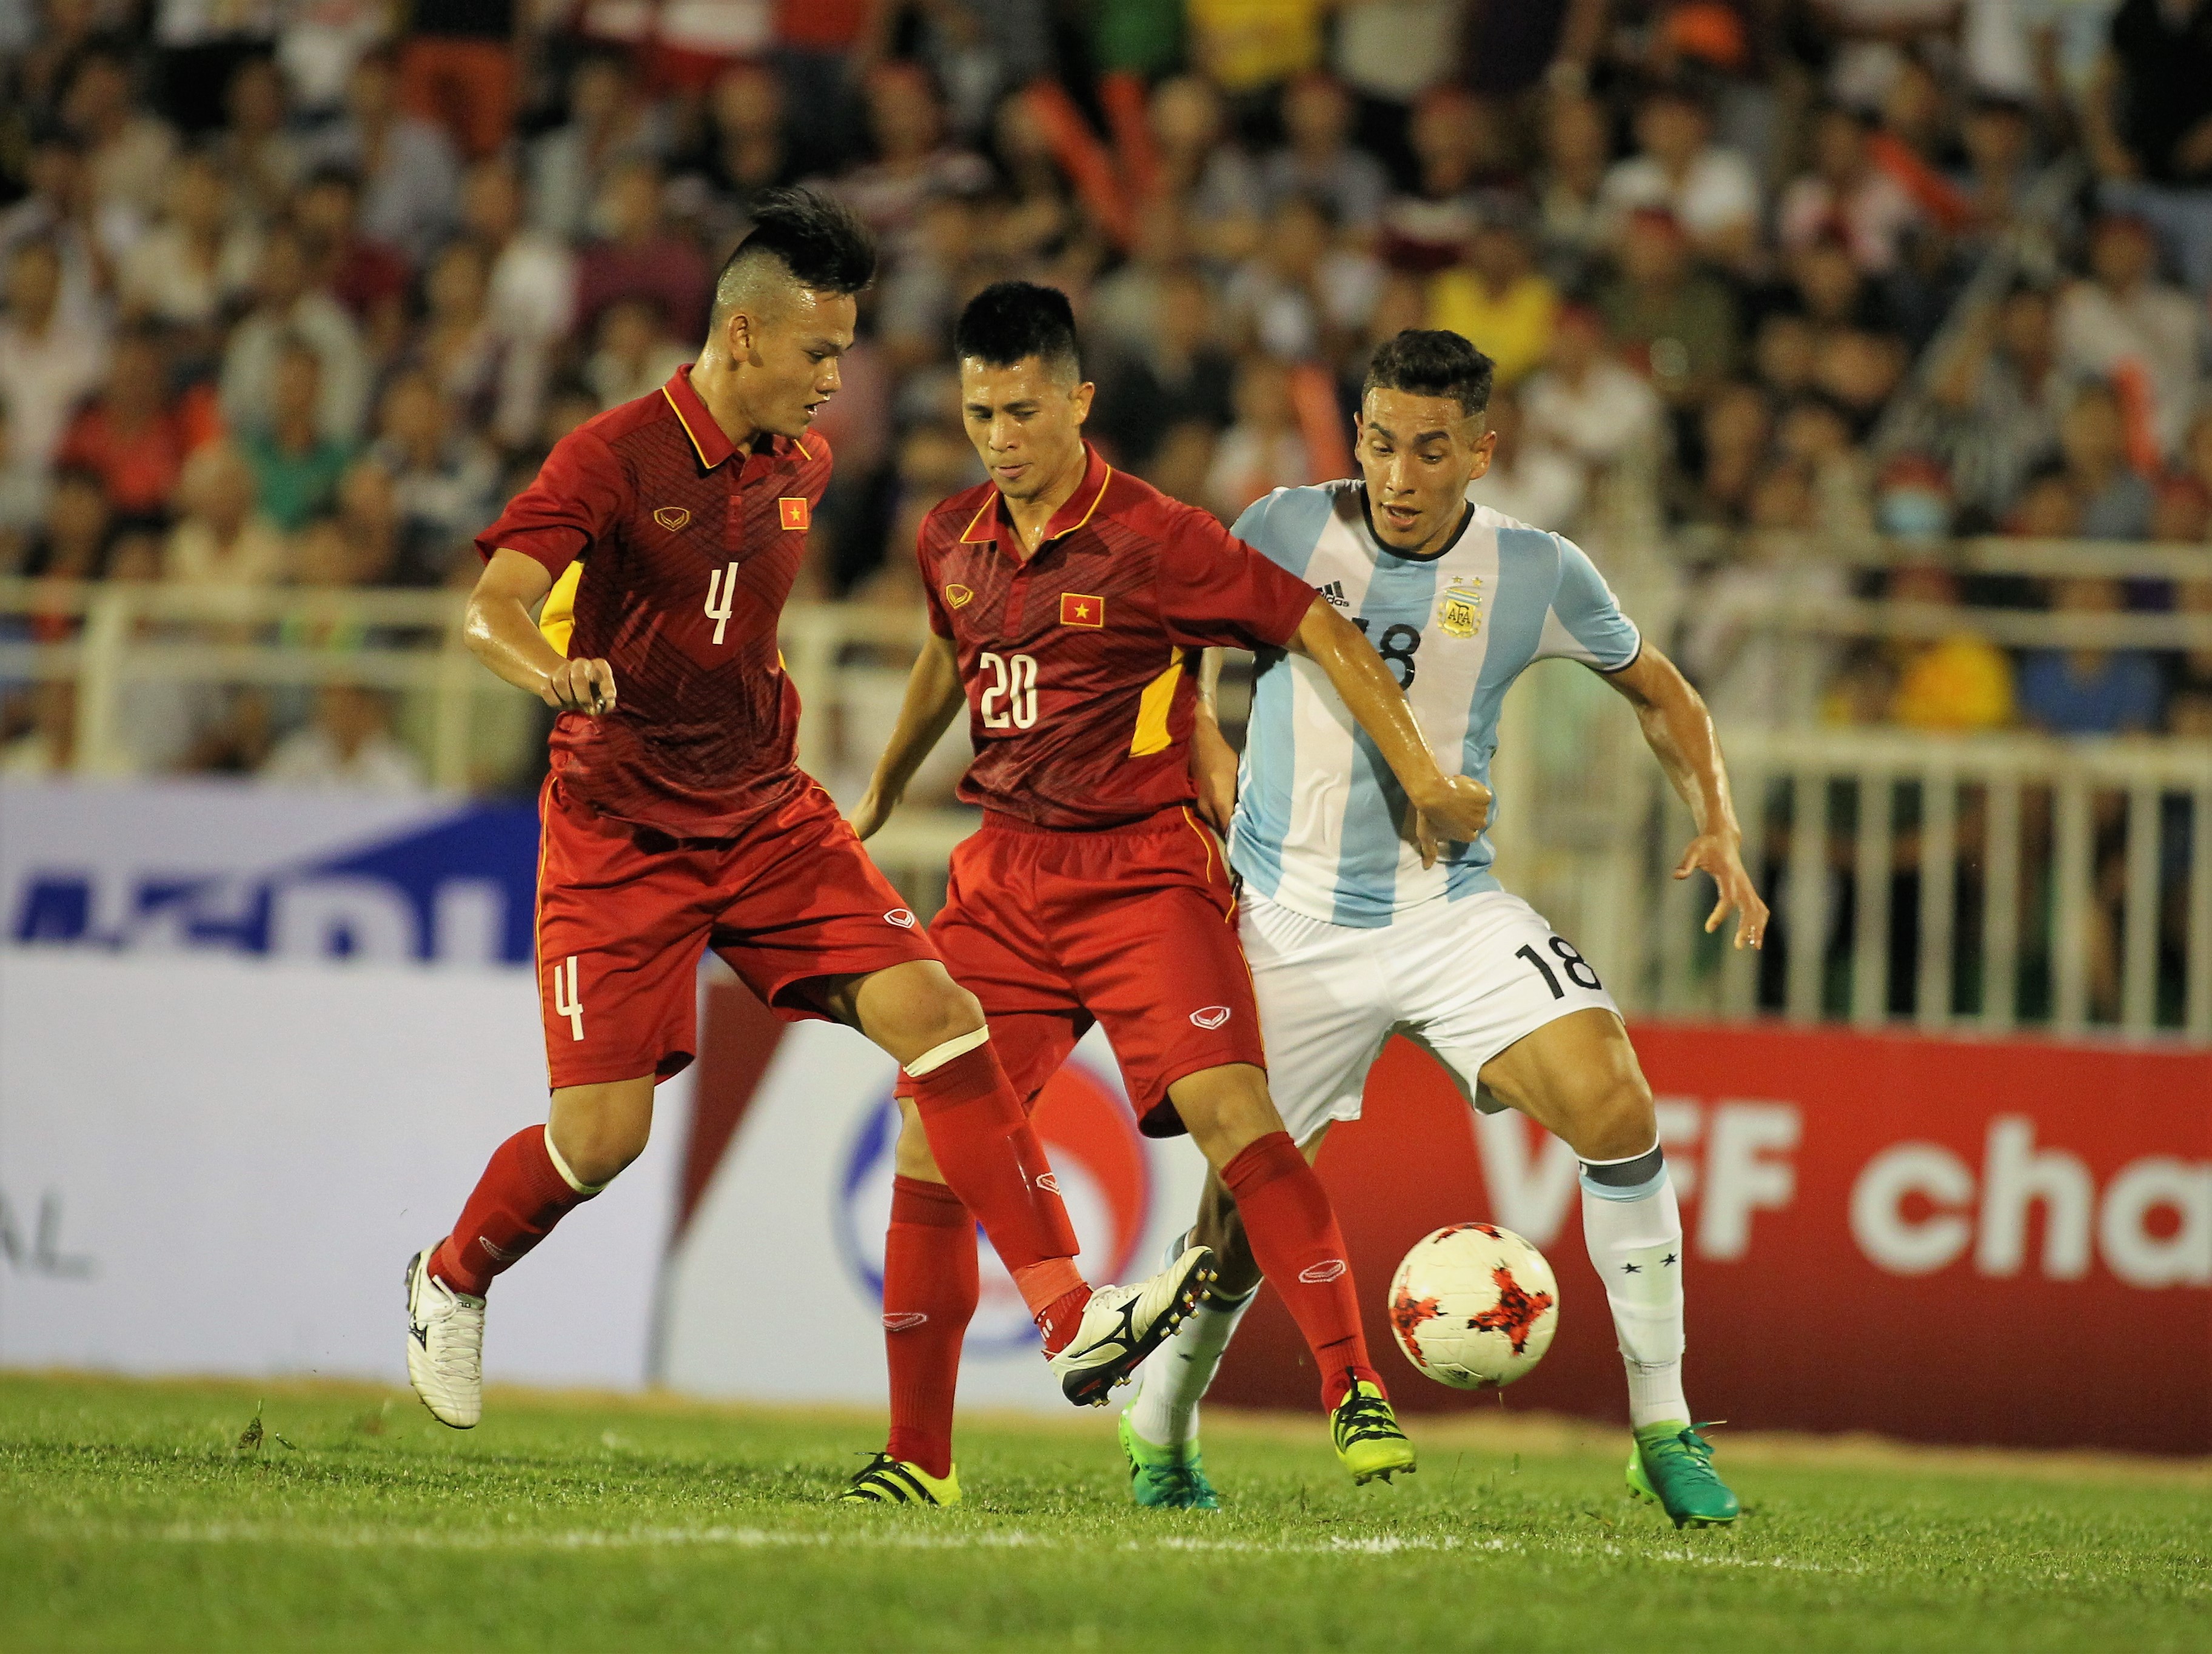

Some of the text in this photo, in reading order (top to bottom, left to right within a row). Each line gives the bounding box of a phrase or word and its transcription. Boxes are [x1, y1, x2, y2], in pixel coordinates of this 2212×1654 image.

[703, 561, 739, 645] 4
[1322, 592, 1350, 607] das
[1447, 603, 1472, 626] AFA
[980, 652, 1039, 729] 20
[1352, 617, 1421, 691] 8
[554, 956, 584, 1042] 4
[1515, 936, 1603, 1000] 18
[1849, 1113, 2212, 1289] cha
